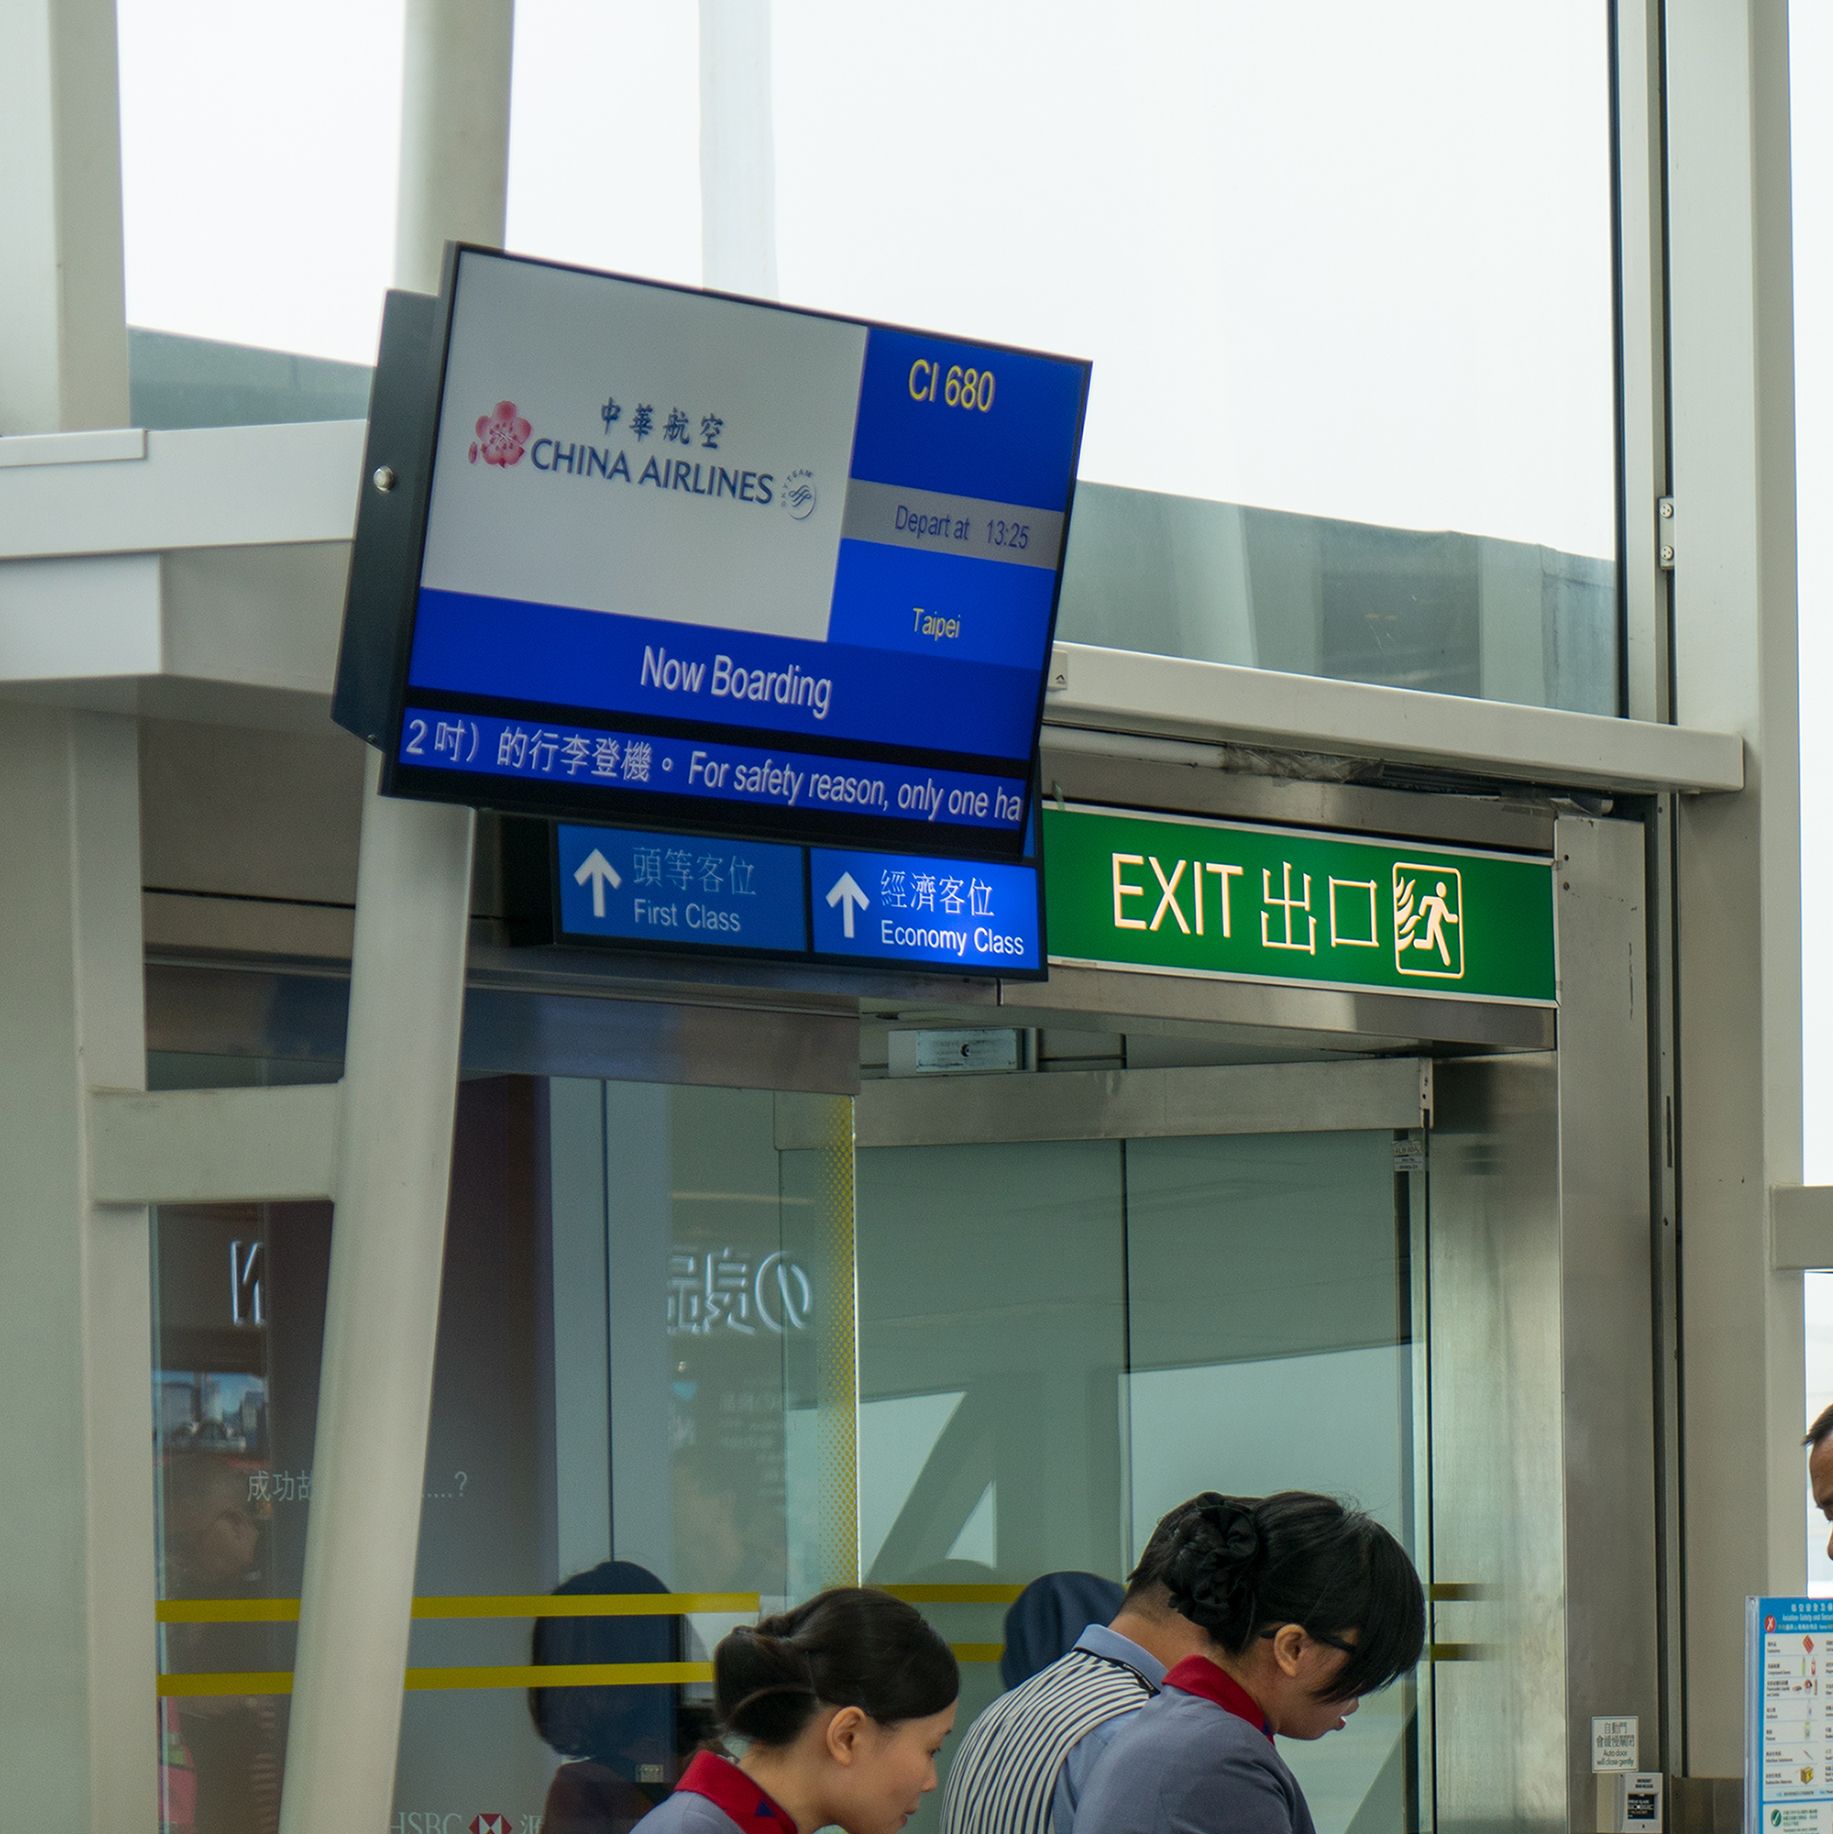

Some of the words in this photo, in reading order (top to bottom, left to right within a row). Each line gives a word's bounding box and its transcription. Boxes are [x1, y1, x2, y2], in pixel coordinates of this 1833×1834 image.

[908, 358, 938, 403] CI
[944, 364, 996, 412] 680
[600, 396, 724, 449] 中華航空
[531, 437, 632, 483] CHINA
[638, 455, 774, 505] AIRLINES
[895, 505, 951, 540] Depart
[954, 517, 970, 541] at
[986, 519, 1030, 550] 13:25
[912, 607, 961, 642] Taipei
[640, 644, 704, 694] Now
[710, 653, 832, 720] Boarding
[688, 750, 729, 789] For
[733, 757, 802, 806] safety
[809, 775, 888, 810] reason,
[897, 778, 943, 822] only
[946, 790, 988, 819] one
[993, 785, 1023, 823] ha
[633, 846, 757, 897] 頭等客位
[880, 868, 995, 918] 經濟客位
[634, 899, 678, 928] First
[685, 903, 741, 933] Class
[1112, 852, 1244, 938] EXIT
[1261, 861, 1380, 956] 出口
[881, 919, 967, 957] Economy
[974, 928, 1025, 956] Class
